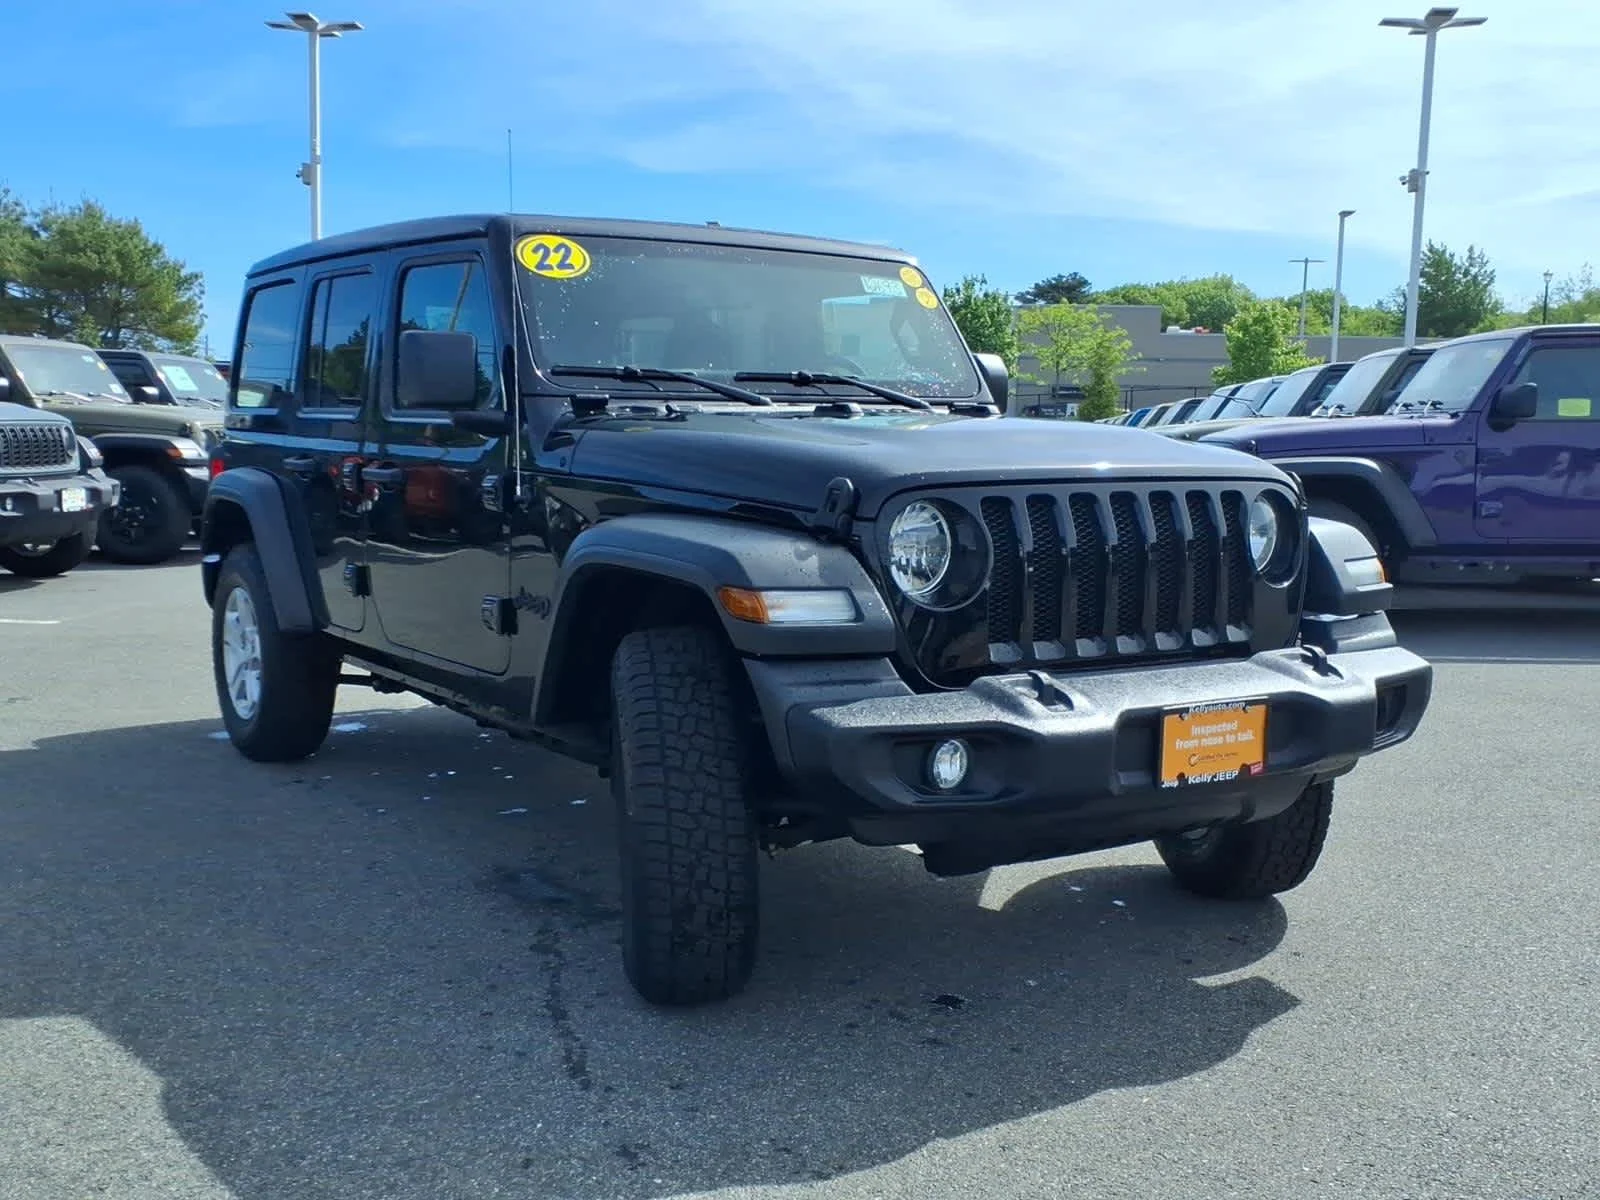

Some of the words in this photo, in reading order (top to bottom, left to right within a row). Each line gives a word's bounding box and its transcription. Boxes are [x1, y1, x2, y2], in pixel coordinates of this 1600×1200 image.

[531, 242, 575, 271] 22
[1192, 720, 1238, 736] Inspected
[1176, 739, 1198, 750] from
[1201, 736, 1223, 746] nose
[1226, 733, 1236, 743] to
[1187, 773, 1212, 785] Kelly
[1213, 769, 1239, 781] JEEP
